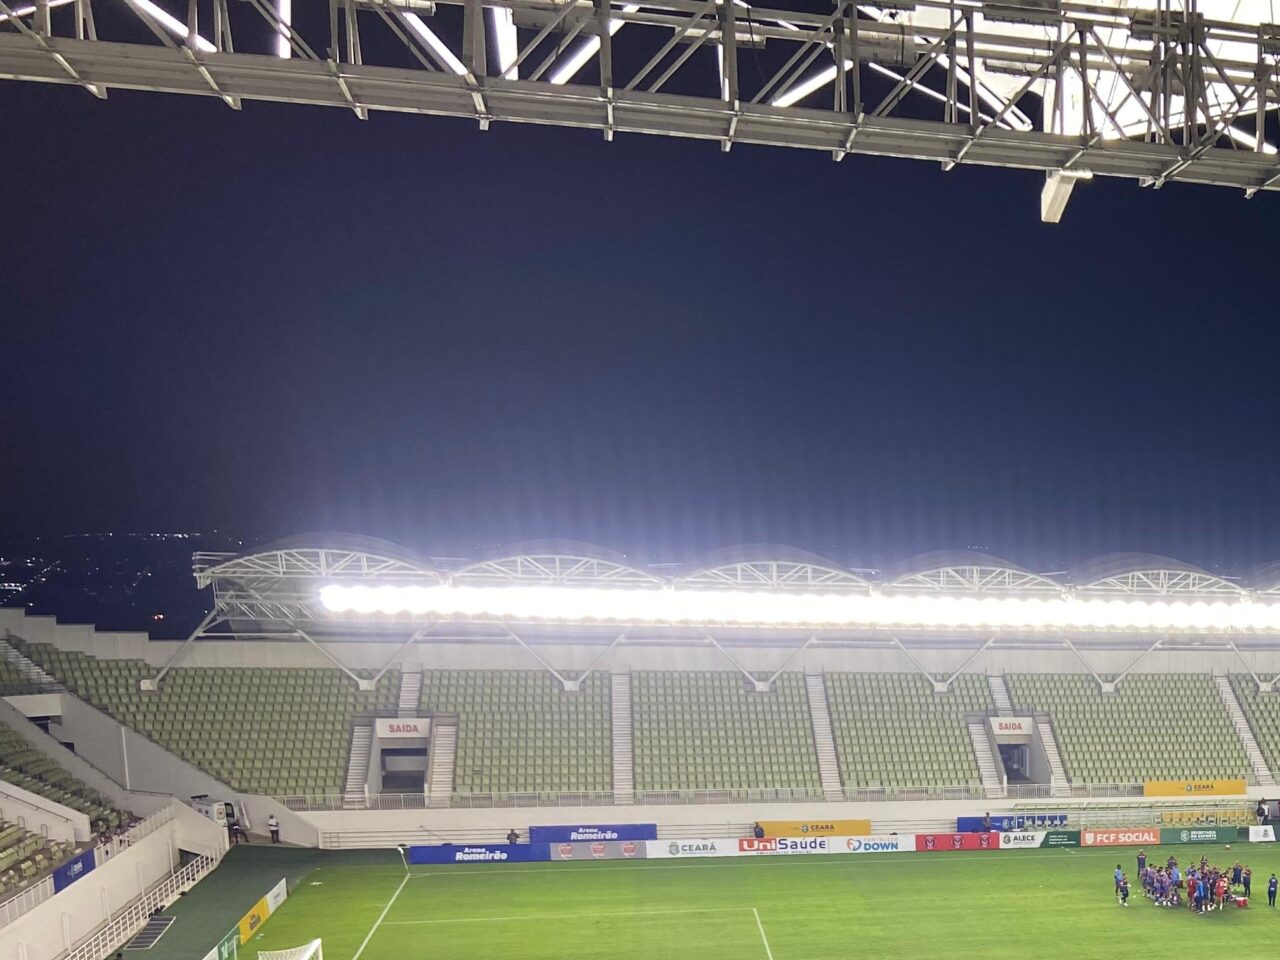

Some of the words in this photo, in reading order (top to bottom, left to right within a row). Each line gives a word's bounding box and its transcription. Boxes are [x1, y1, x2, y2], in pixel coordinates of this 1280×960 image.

[570, 830, 618, 840] Romeirão
[1096, 833, 1117, 843] FCF
[1118, 832, 1156, 842] SOCIAL
[681, 841, 717, 852] CEARÁ
[742, 837, 827, 851] UniSaúde
[863, 842, 898, 851] DOWN
[455, 850, 508, 861] Romeirão
